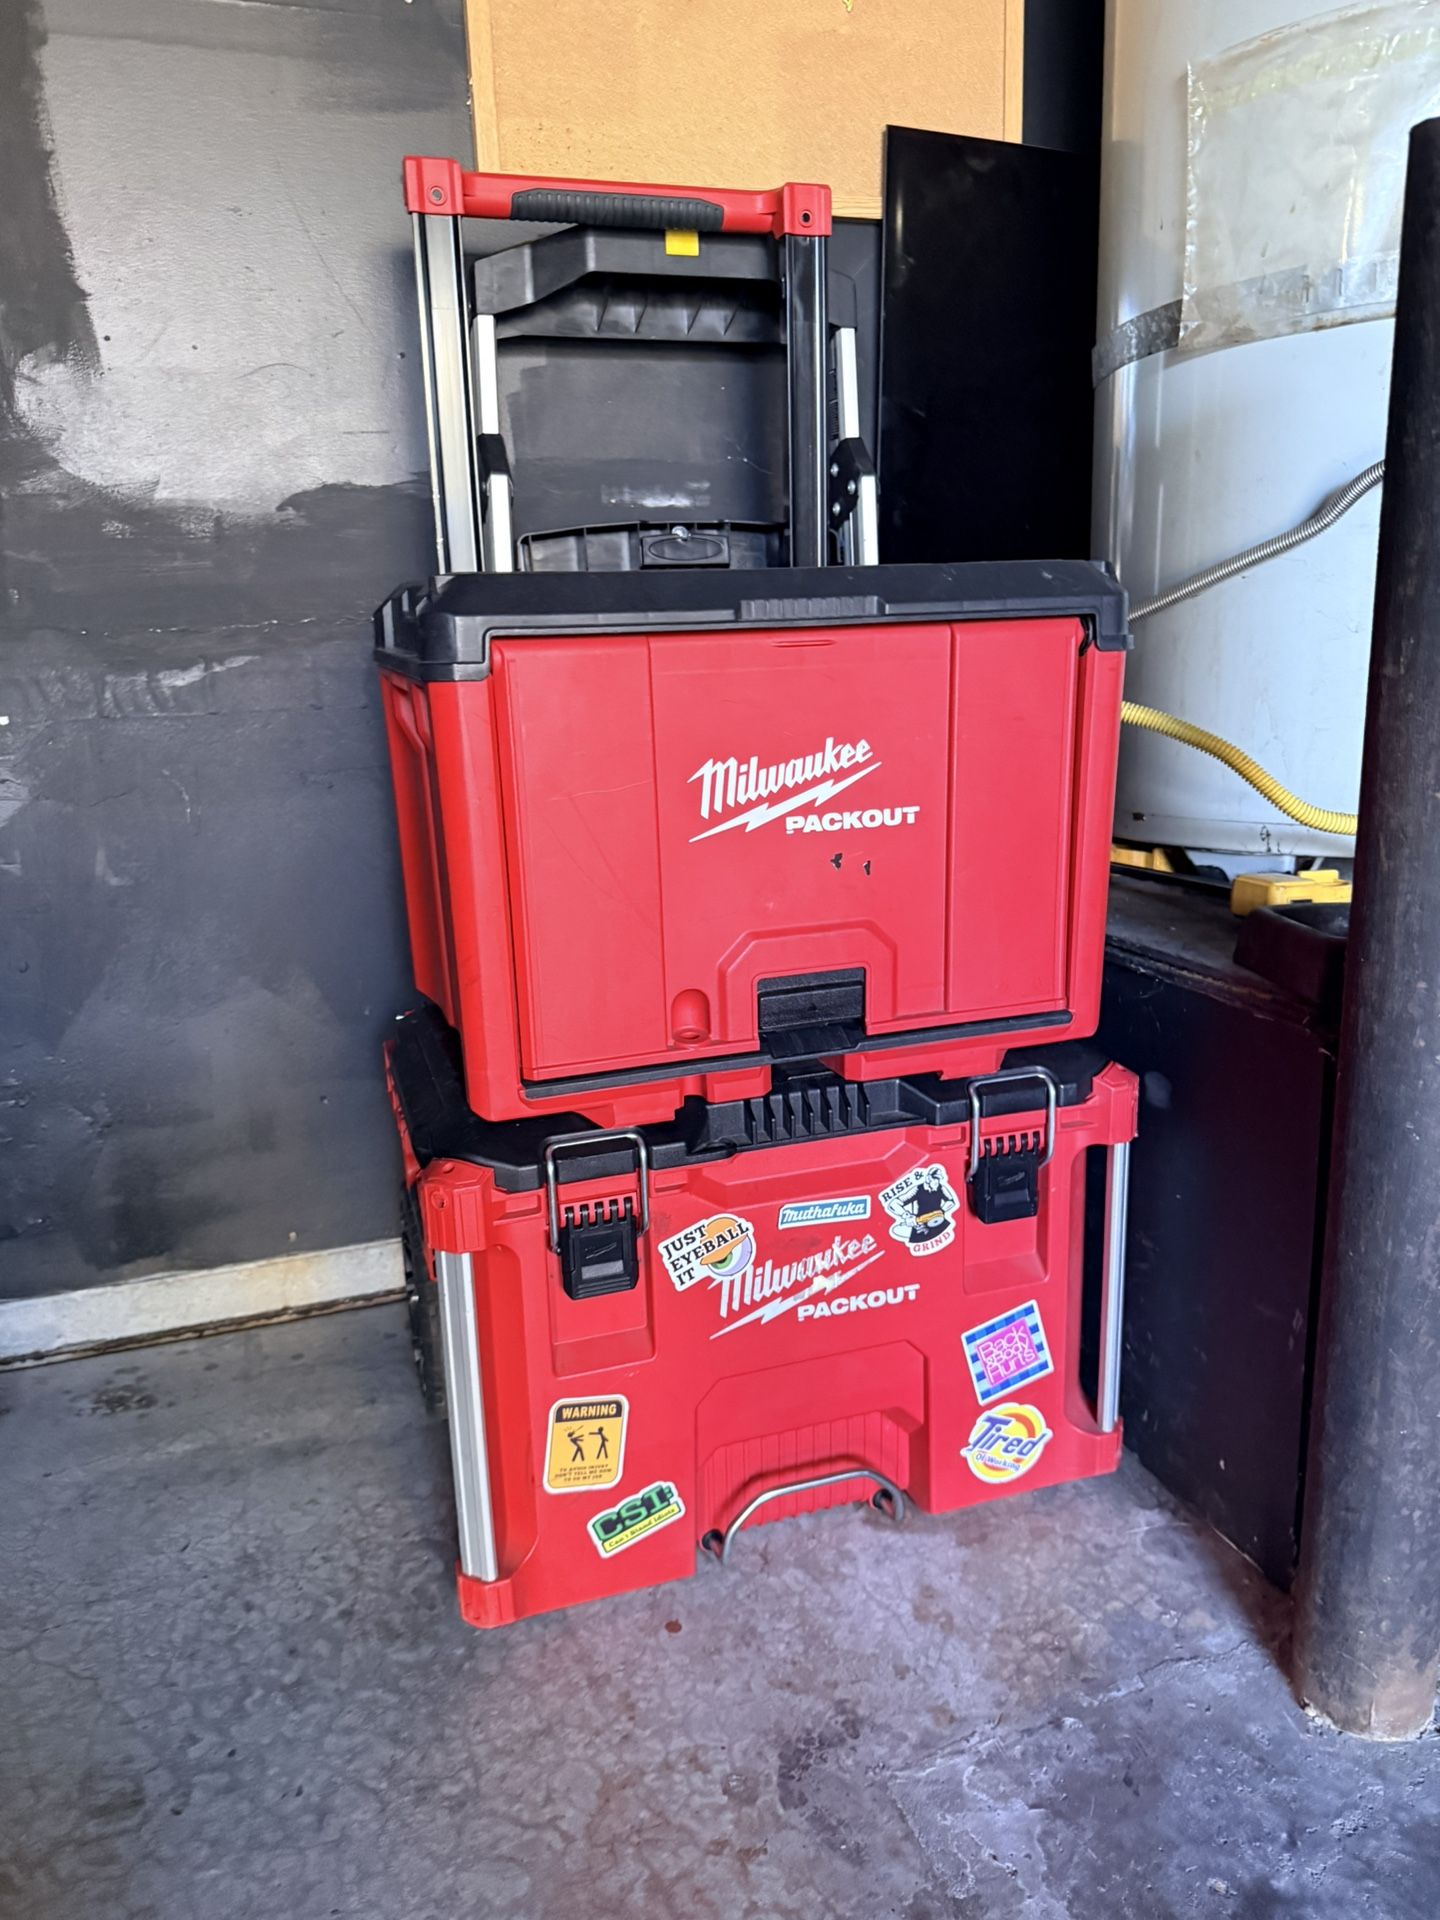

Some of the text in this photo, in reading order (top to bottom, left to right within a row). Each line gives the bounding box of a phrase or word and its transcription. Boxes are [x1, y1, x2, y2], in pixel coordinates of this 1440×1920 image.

[687, 737, 873, 819] Milwaukee
[785, 806, 920, 834] PACKOUT
[881, 1171, 924, 1202] RISE &
[663, 1224, 706, 1260] JUST
[670, 1222, 749, 1272] EYEBALL
[913, 1231, 951, 1253] GRIND
[676, 1267, 695, 1286] IT
[707, 1234, 877, 1318] Milwaukee
[797, 1284, 920, 1321] PACKOUT
[987, 1348, 1036, 1383] Hurts
[562, 1404, 617, 1419] WARNING
[968, 1414, 1048, 1457] Tired
